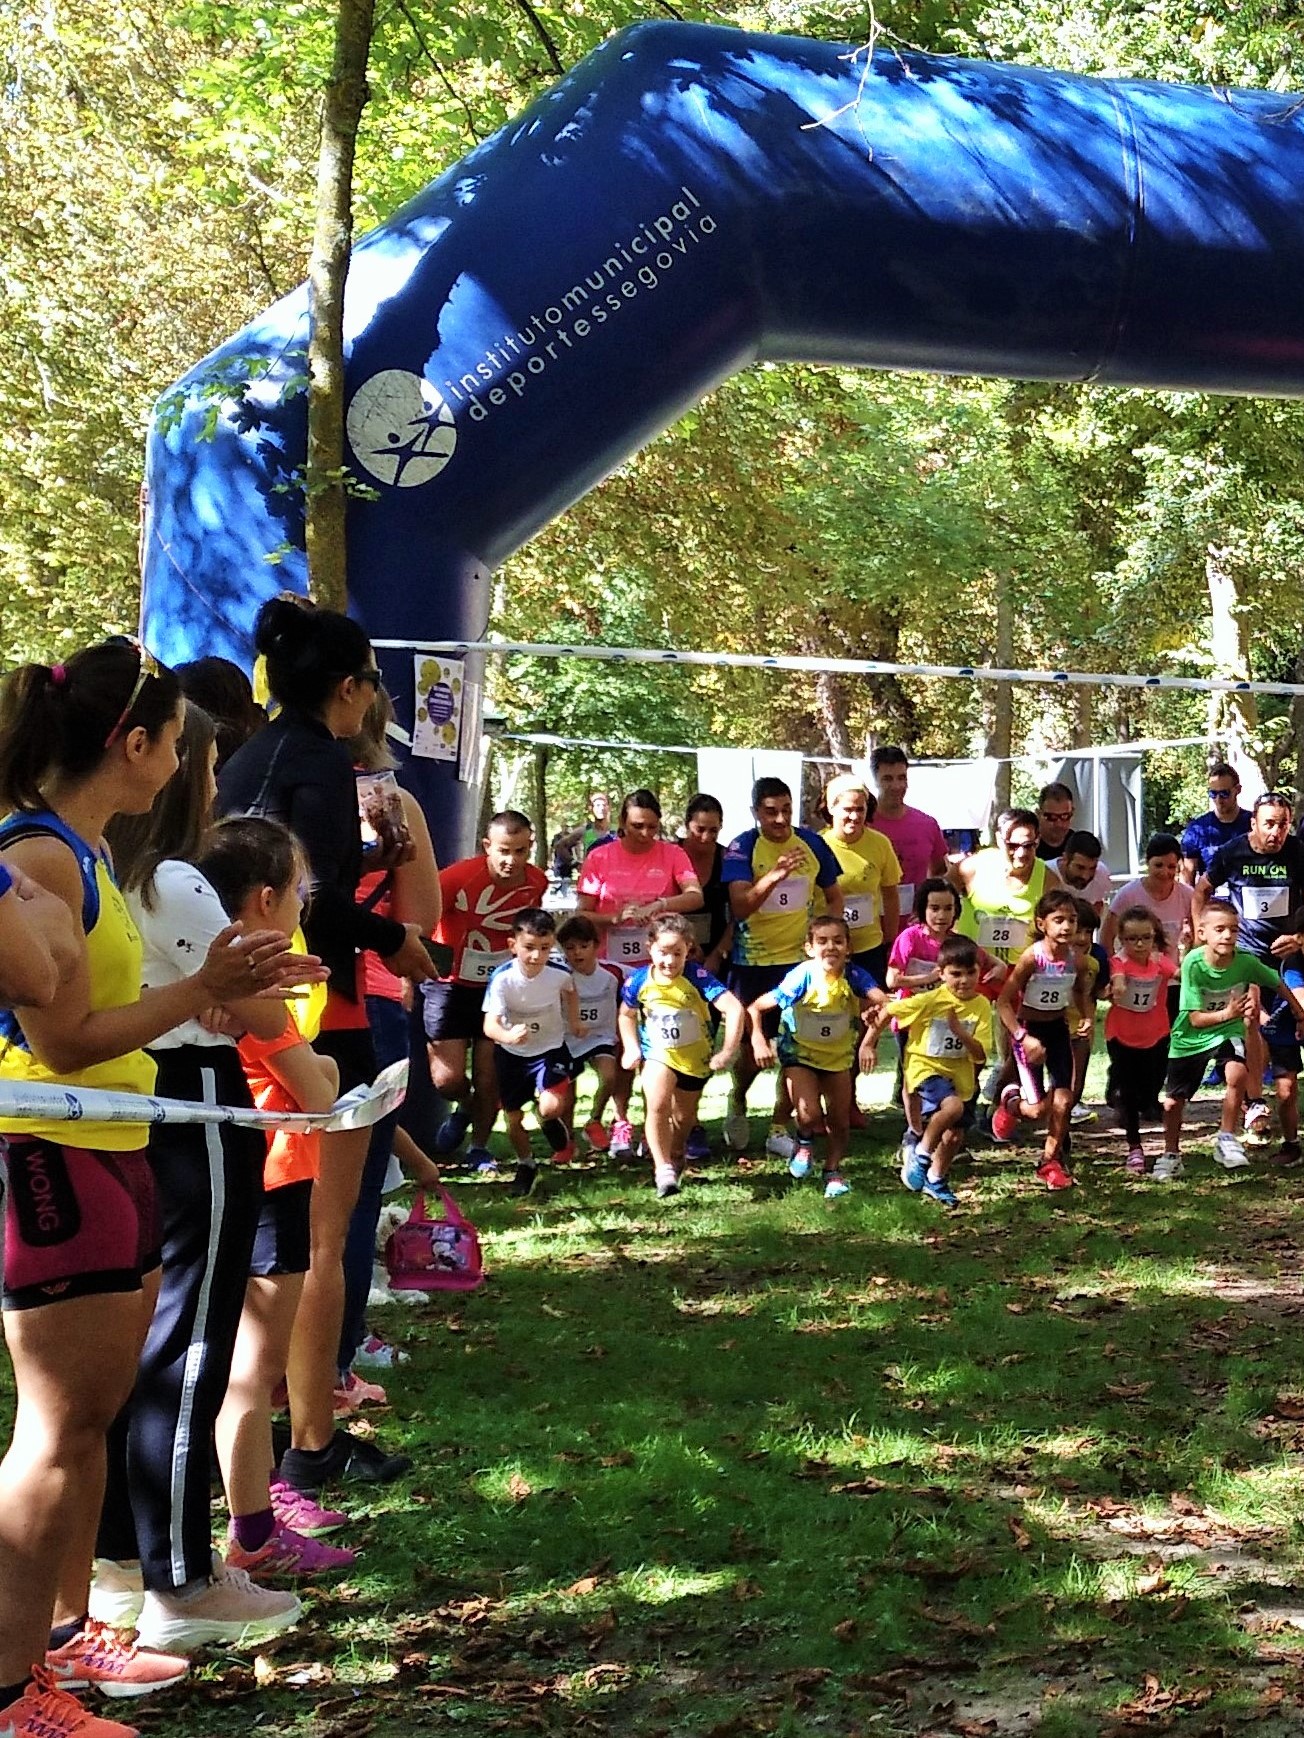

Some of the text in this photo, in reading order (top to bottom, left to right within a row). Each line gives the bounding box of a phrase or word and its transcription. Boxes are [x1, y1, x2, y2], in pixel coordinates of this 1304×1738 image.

[449, 186, 703, 401] institutomunicipal
[468, 214, 719, 421] deportessegovia
[1242, 864, 1266, 876] RUN
[779, 893, 788, 906] 8
[1260, 901, 1269, 913] 3
[992, 929, 1010, 942] 28
[622, 941, 641, 955] 58
[1040, 990, 1060, 1004] 28
[1132, 993, 1150, 1005] 17
[580, 1008, 598, 1022] 58
[661, 1027, 680, 1040] 30
[820, 1026, 831, 1037] 8
[944, 1037, 963, 1050] 38
[26, 1151, 60, 1232] WONG
